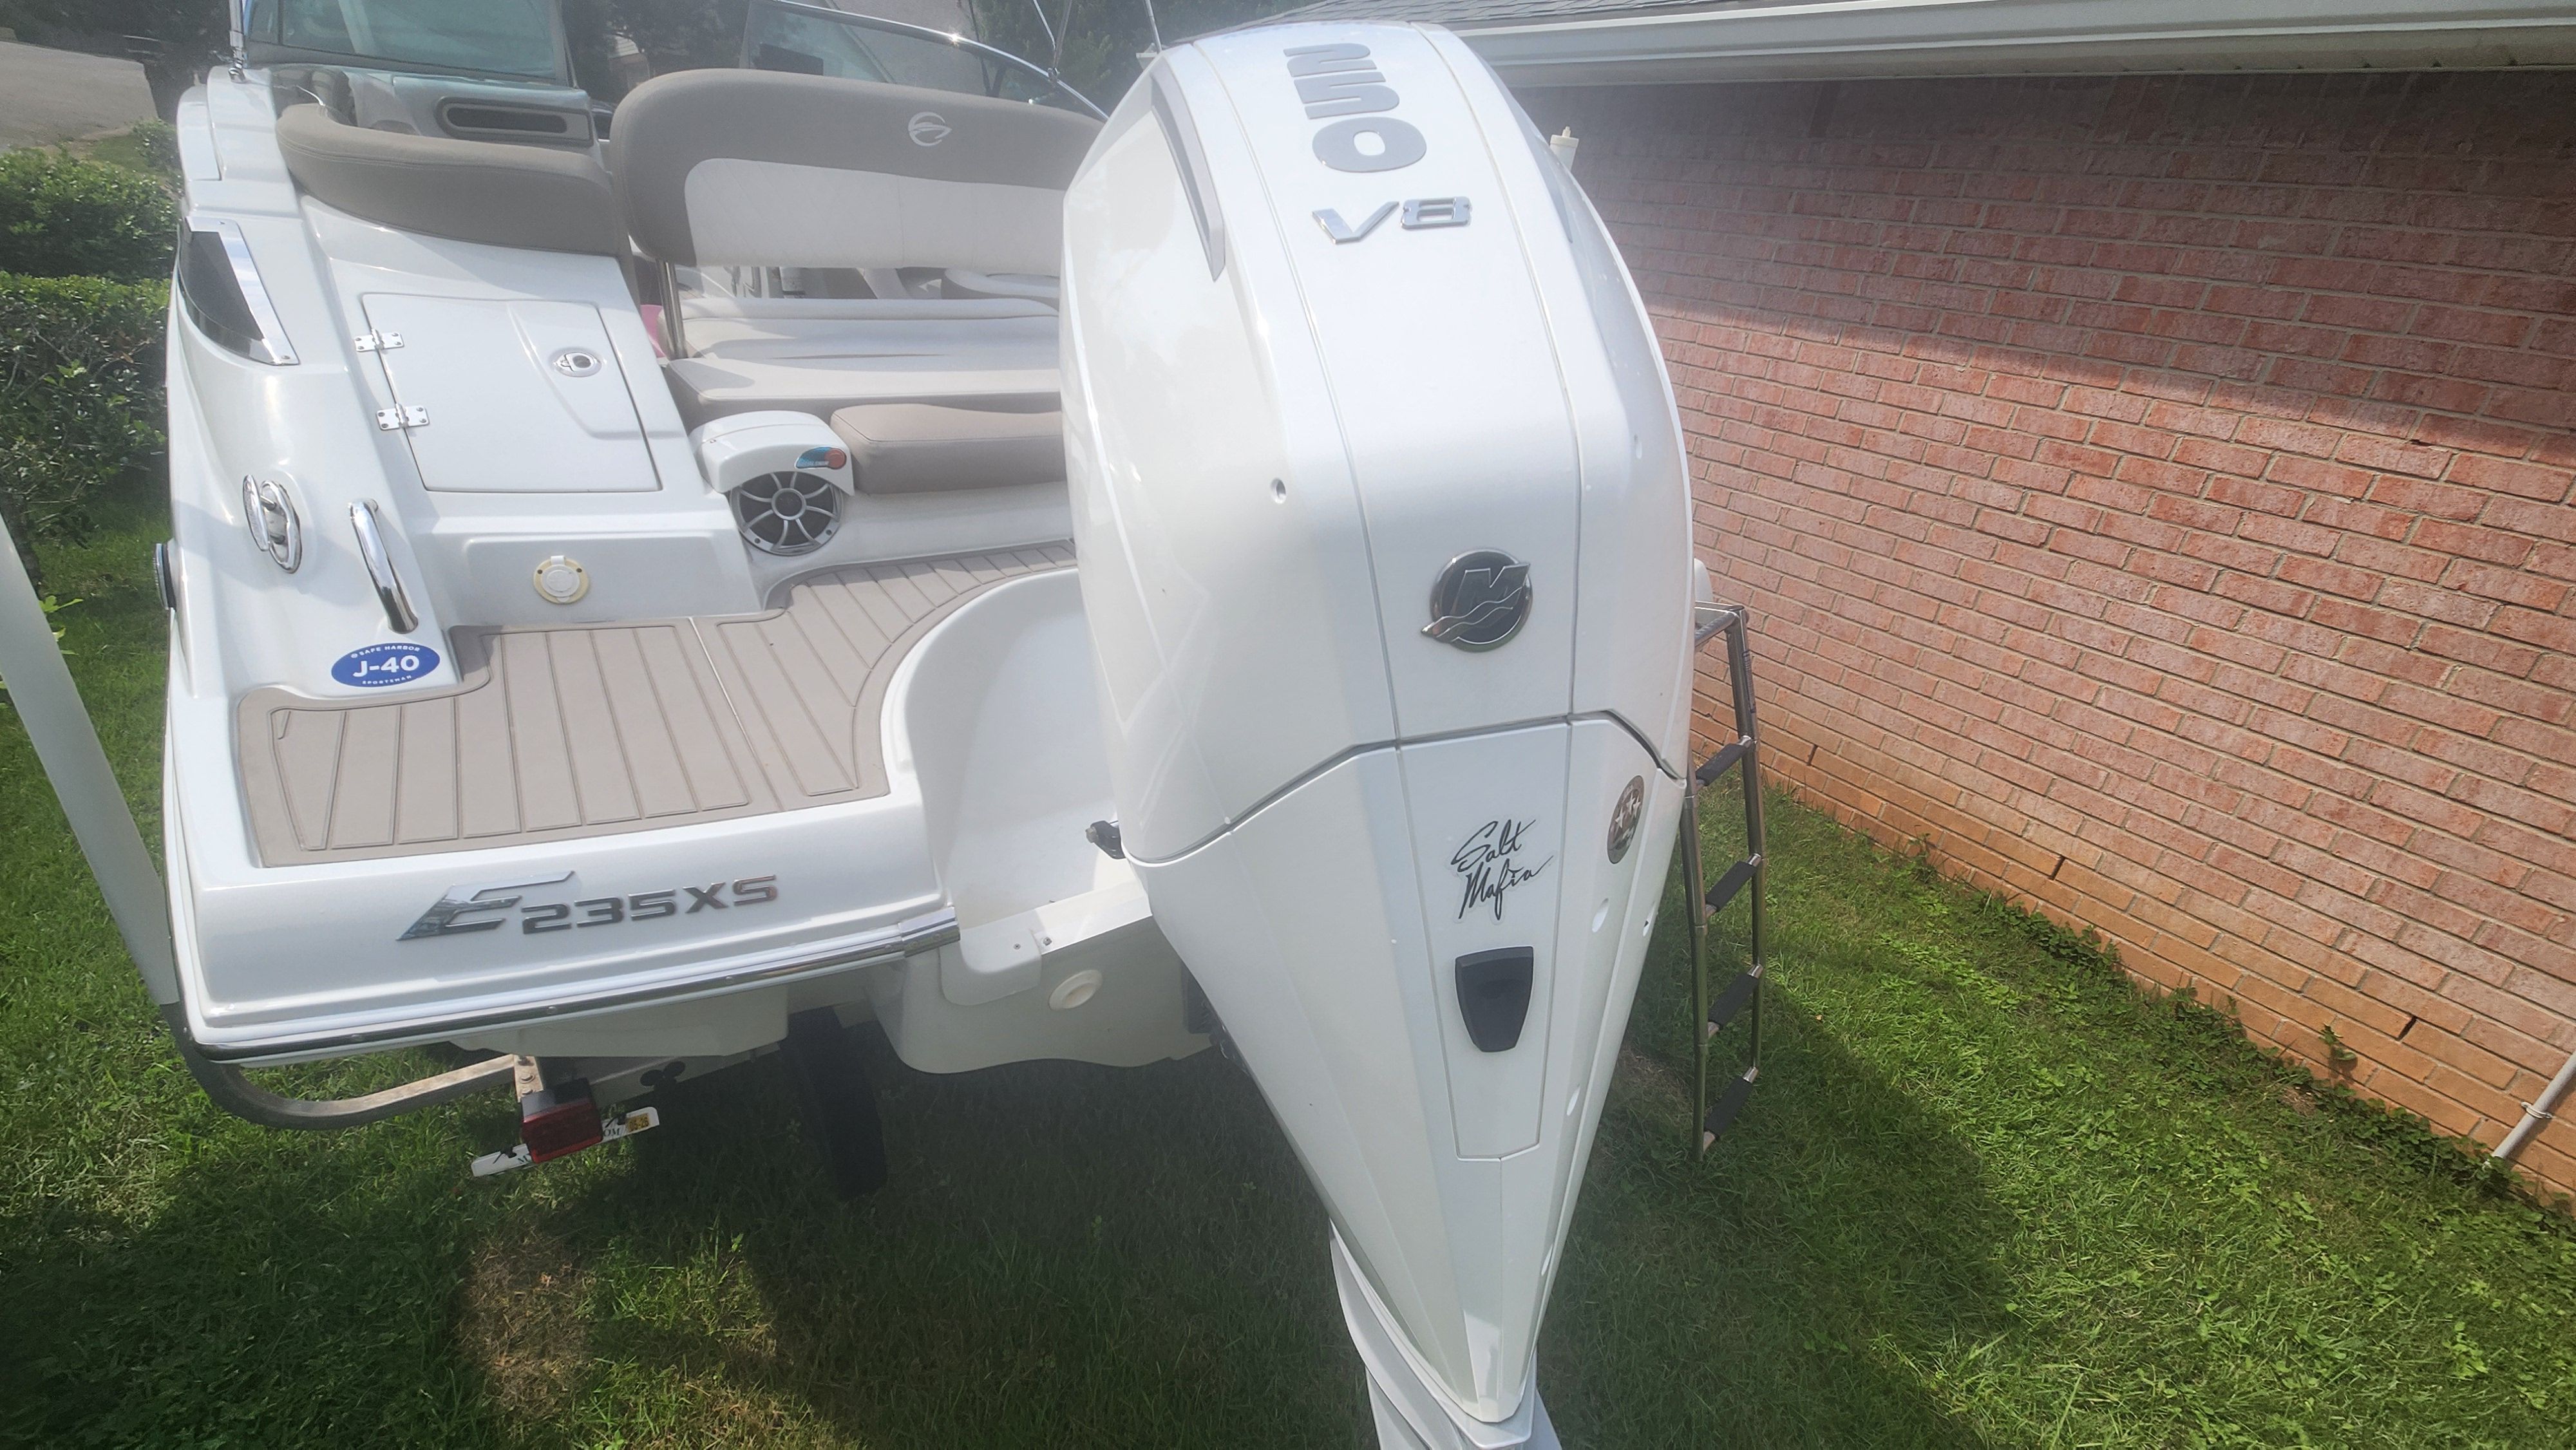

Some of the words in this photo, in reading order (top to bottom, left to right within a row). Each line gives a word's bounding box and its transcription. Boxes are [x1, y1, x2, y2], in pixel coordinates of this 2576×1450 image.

[1283, 42, 1428, 173] 250
[1311, 196, 1472, 245] V8
[352, 655, 420, 677] J-40
[359, 646, 382, 656] SAFE
[362, 675, 412, 684] SPORTSMAN
[1450, 818, 1537, 872] Salt
[1457, 854, 1554, 921] Mafia
